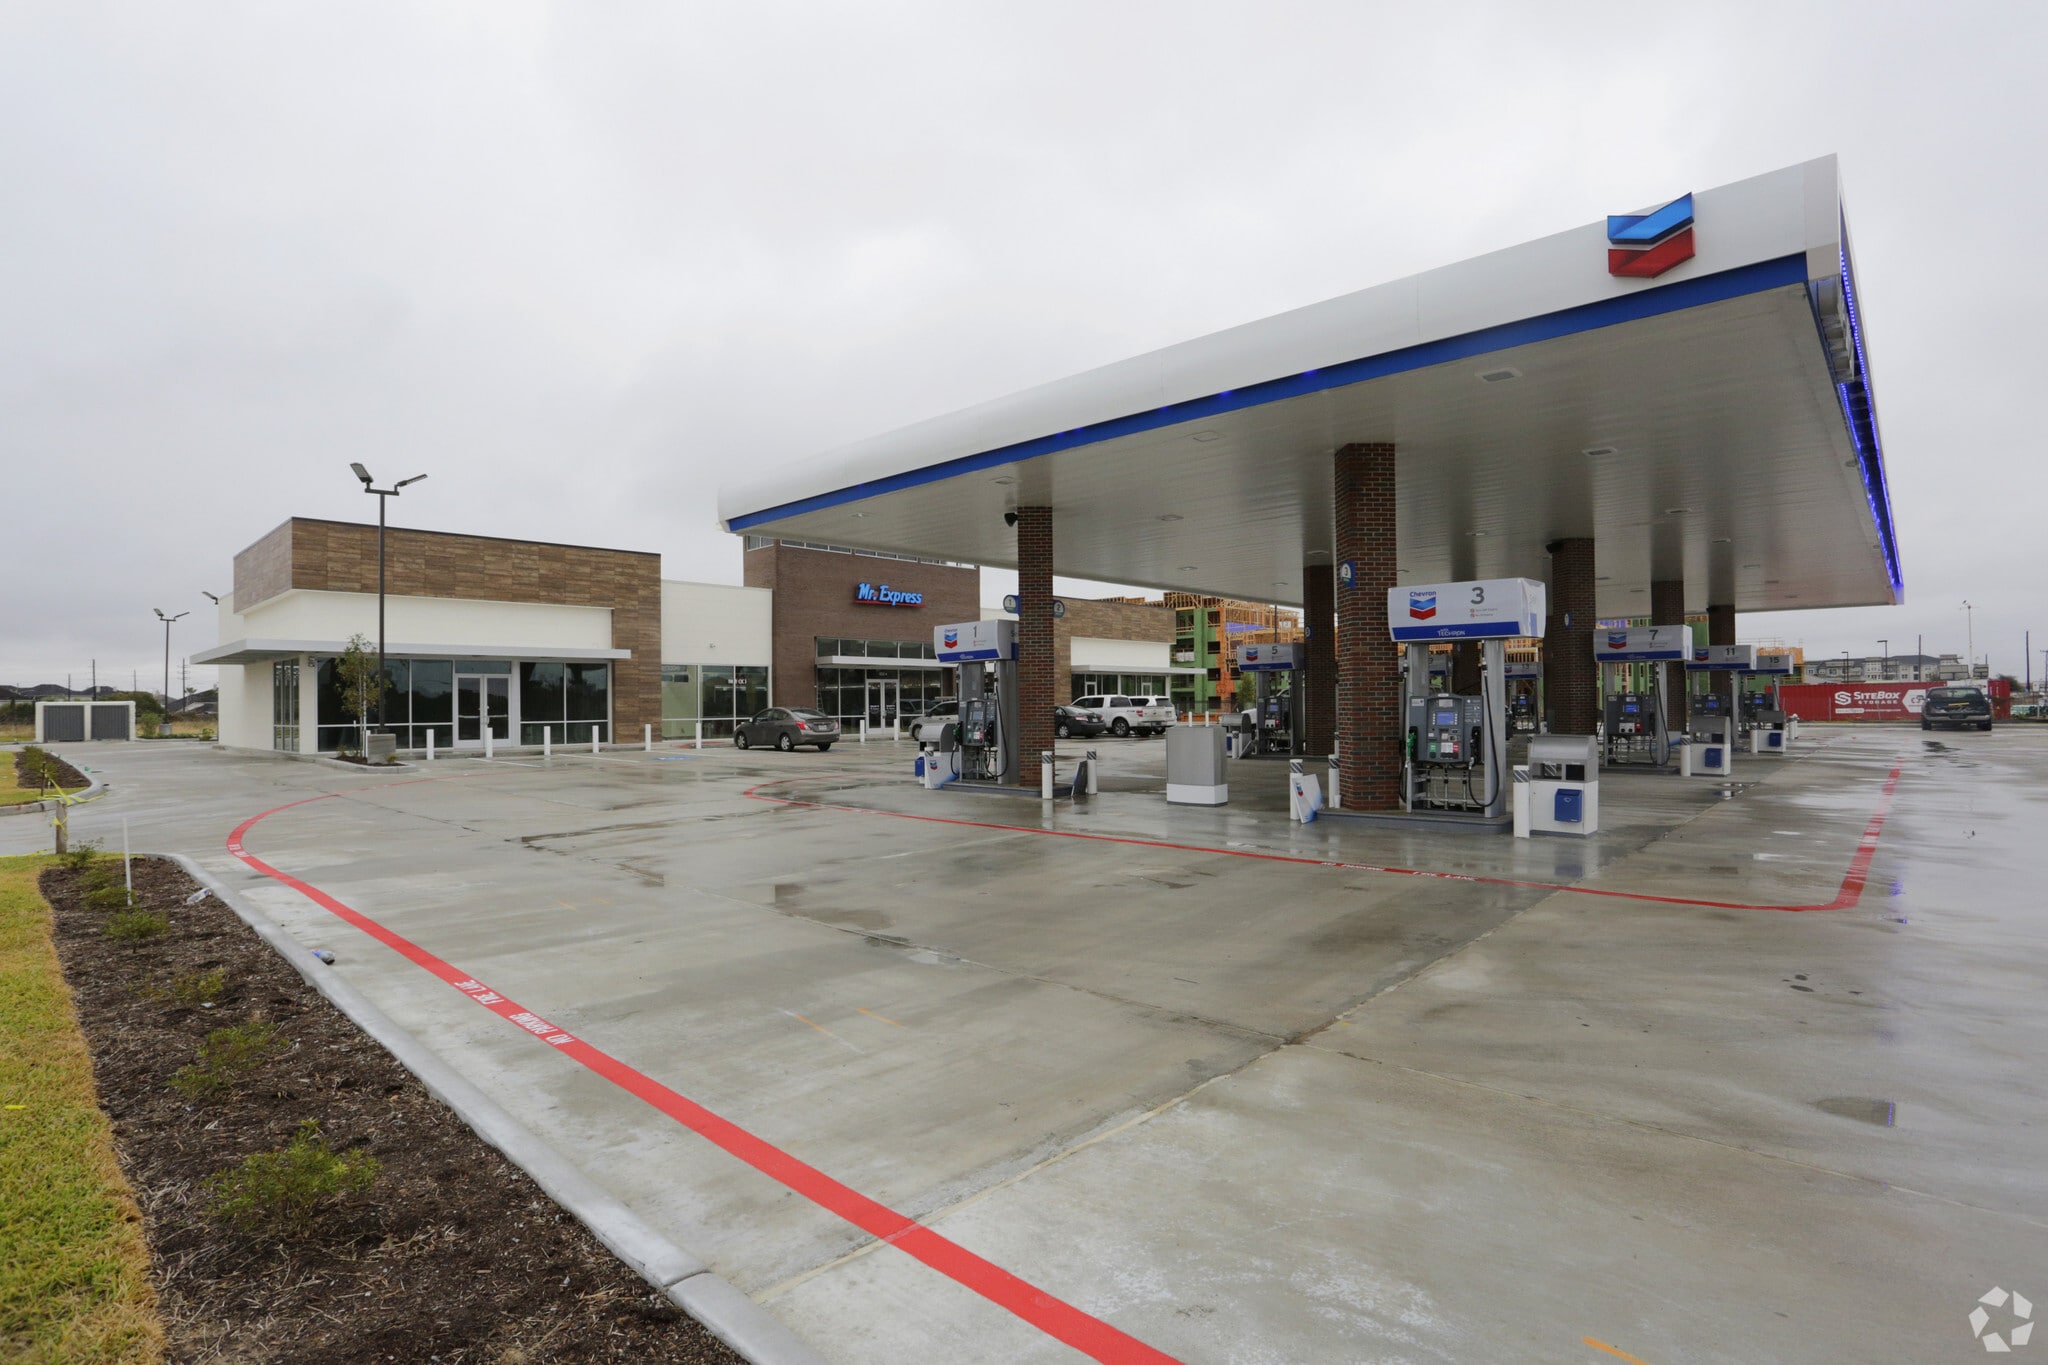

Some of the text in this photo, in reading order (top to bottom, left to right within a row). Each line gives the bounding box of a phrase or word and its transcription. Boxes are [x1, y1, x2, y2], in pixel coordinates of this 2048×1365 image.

[858, 583, 923, 606] Mr. Express
[1470, 587, 1485, 604] 3
[1649, 630, 1659, 640] 7
[1271, 645, 1278, 655] 5
